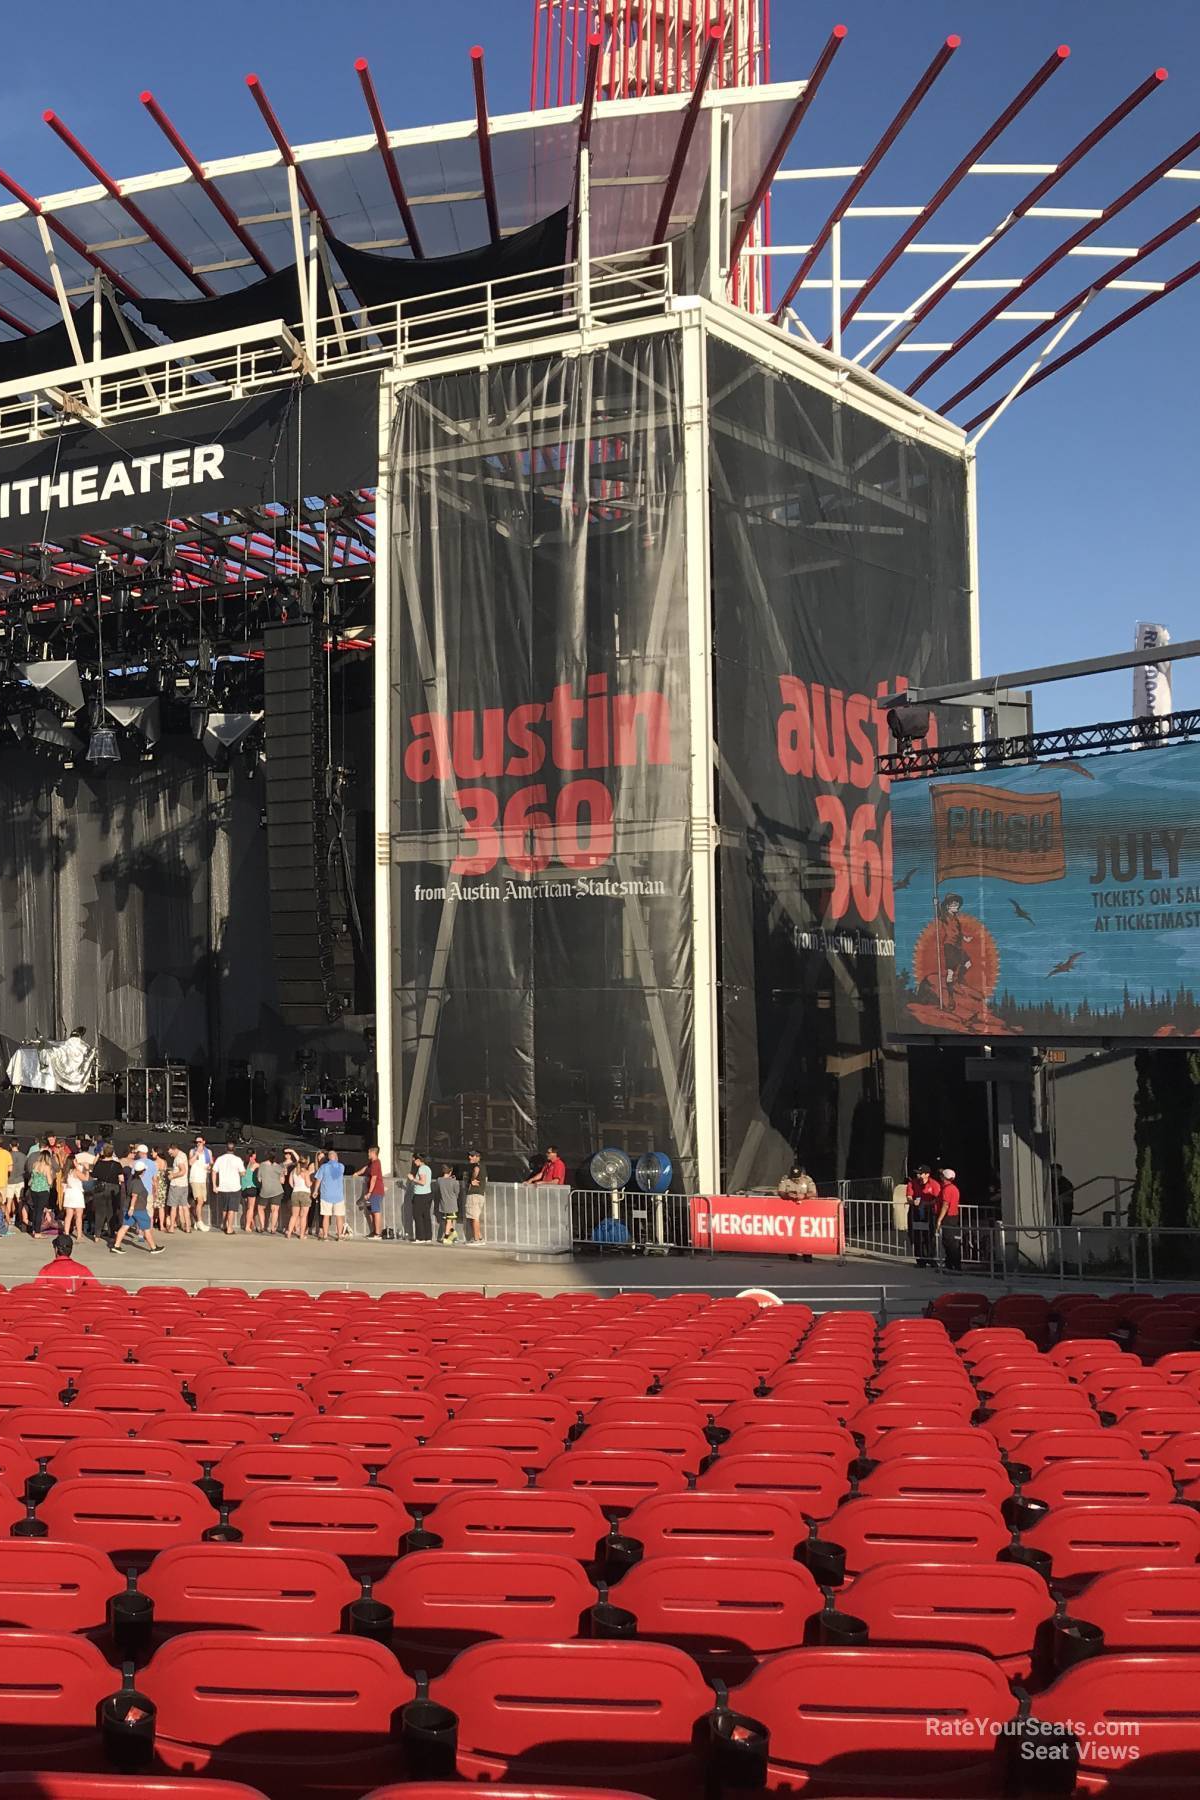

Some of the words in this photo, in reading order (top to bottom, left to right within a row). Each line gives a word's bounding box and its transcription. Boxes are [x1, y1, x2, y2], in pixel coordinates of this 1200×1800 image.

[404, 672, 672, 783] austin
[450, 779, 615, 876] 360
[946, 806, 1054, 854] PHISH
[1089, 829, 1185, 885] JULY
[414, 884, 447, 901] from
[447, 881, 500, 903] Austin
[1091, 889, 1145, 909] TICKETS
[1150, 887, 1171, 905] ON
[1094, 915, 1111, 932] AT
[697, 1213, 795, 1237] EMERGENCY
[800, 1216, 837, 1238] EXIT
